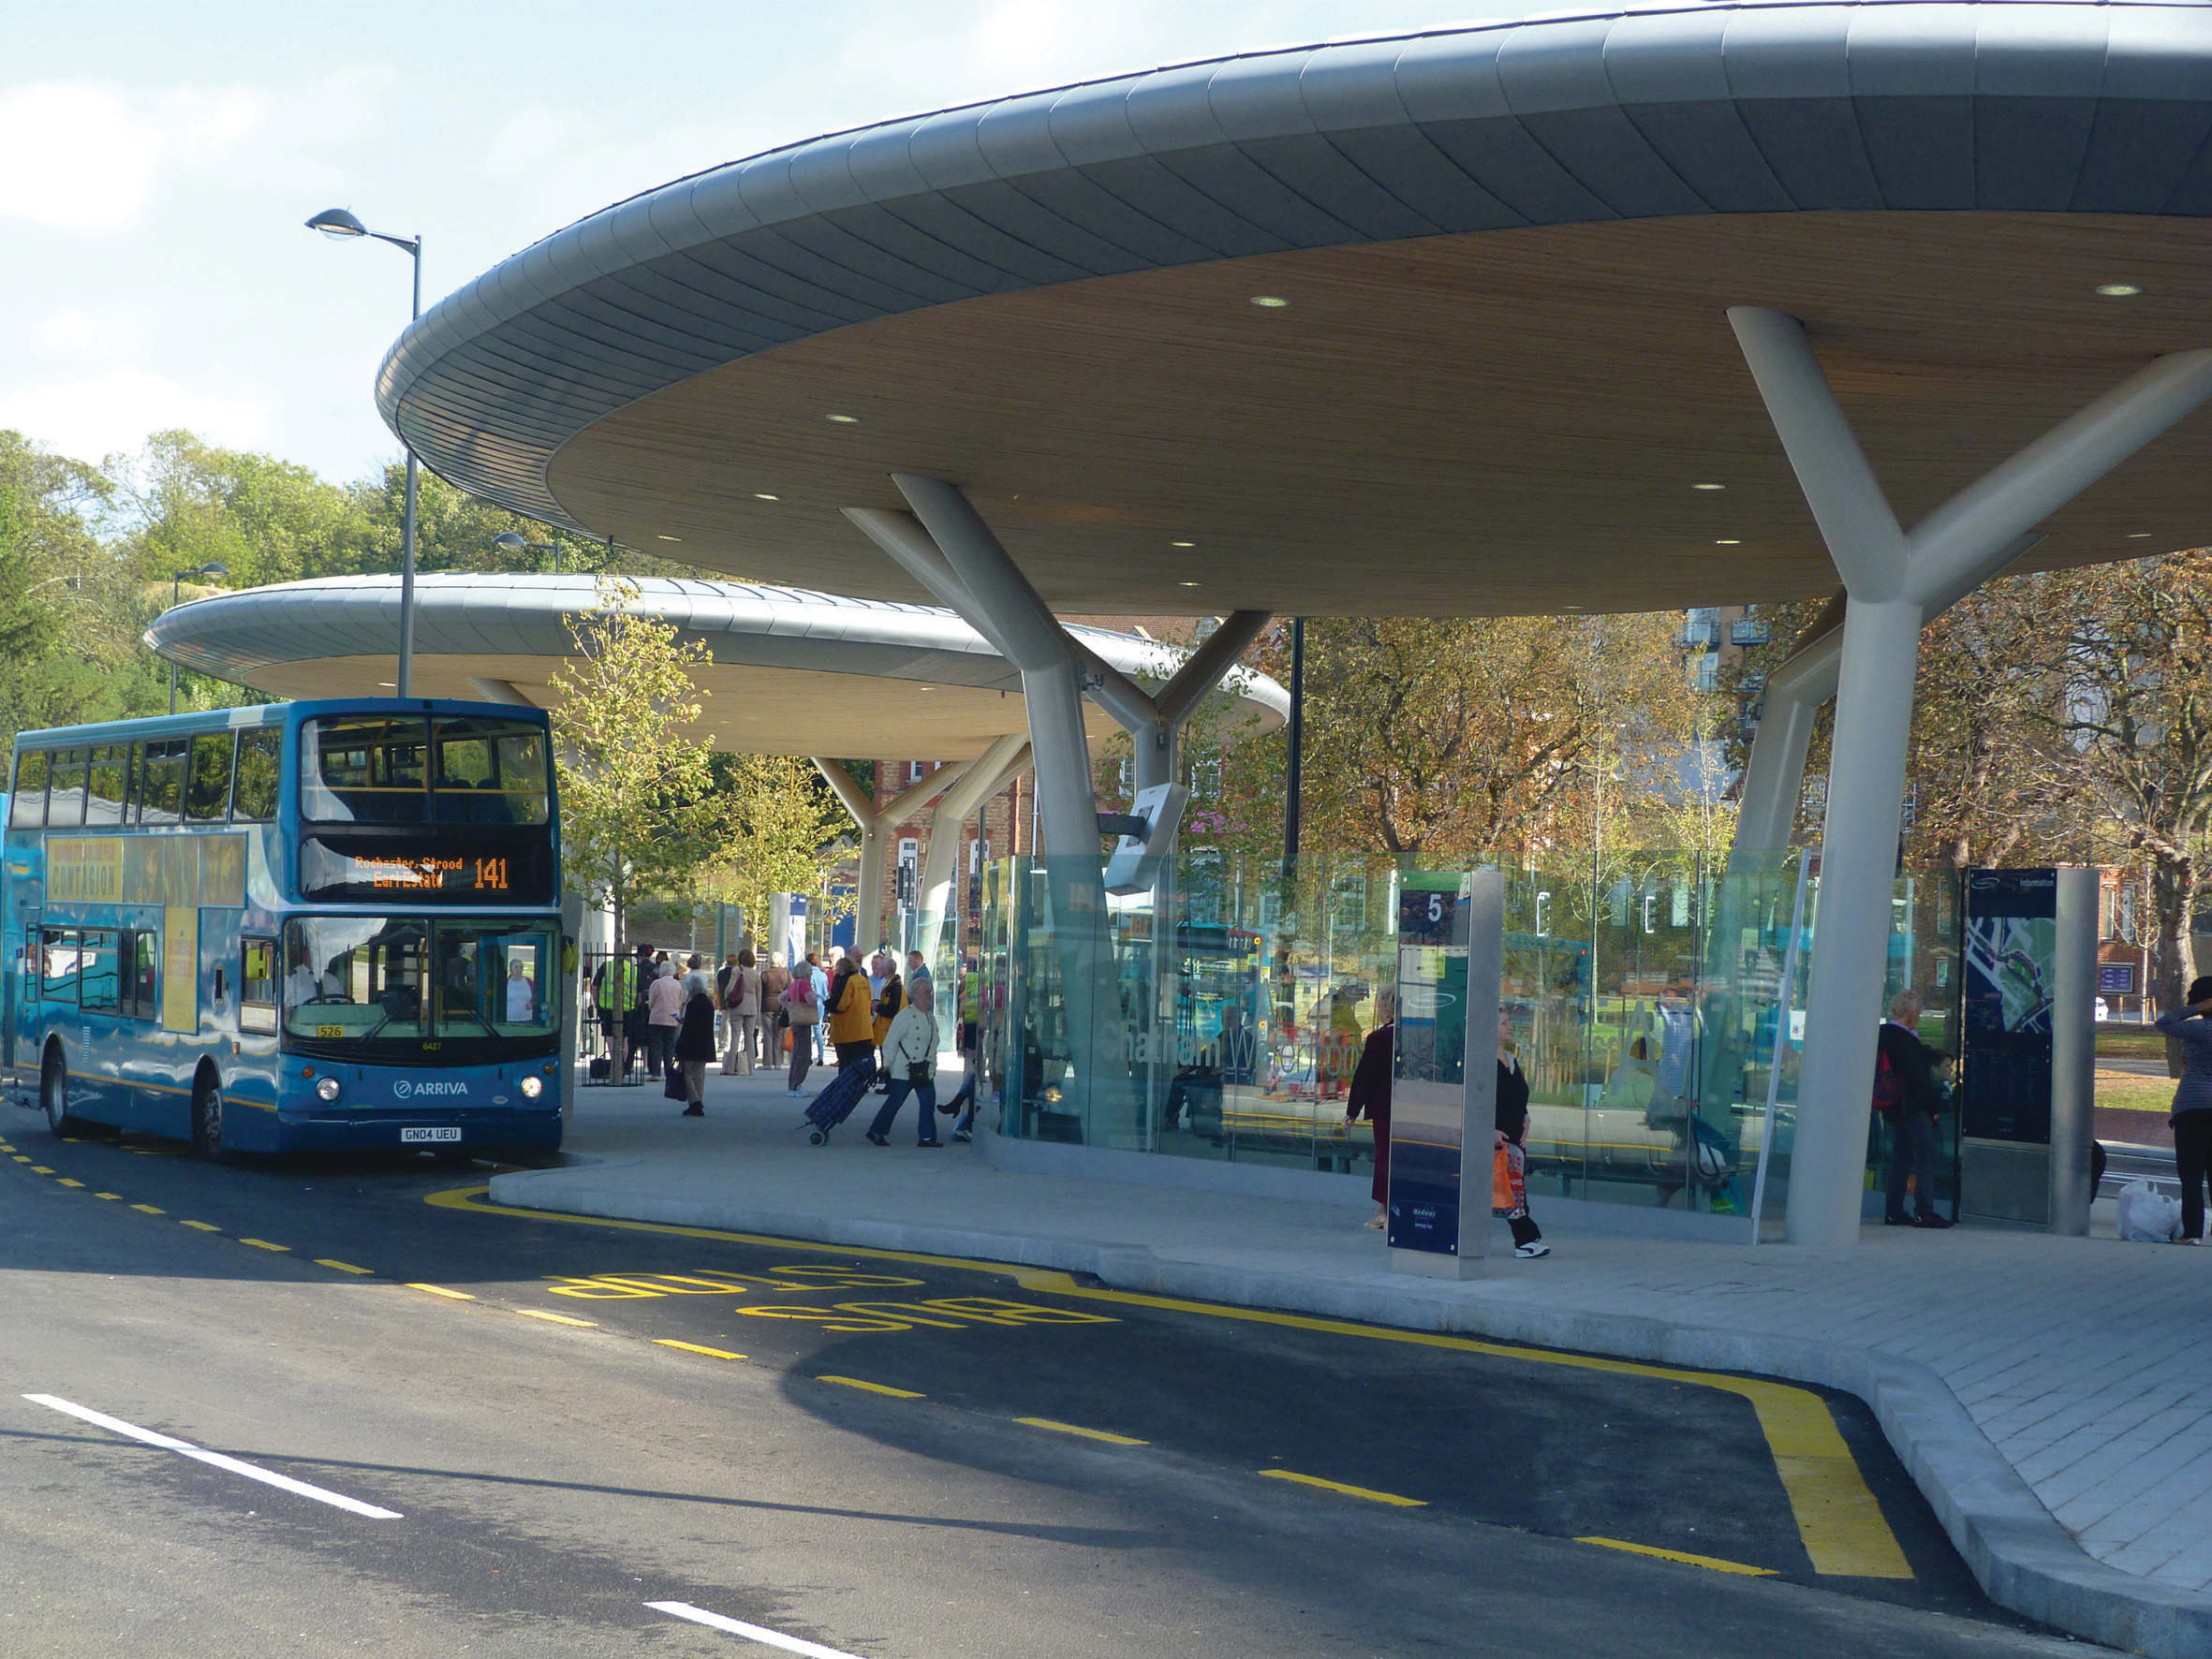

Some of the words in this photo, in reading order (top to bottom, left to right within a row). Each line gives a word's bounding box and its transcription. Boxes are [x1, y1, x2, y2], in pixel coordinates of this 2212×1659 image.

[354, 856, 420, 870] Rochester,
[421, 857, 464, 870] Strood
[52, 864, 116, 897] CONTAGION
[403, 871, 444, 888] Estate
[475, 858, 509, 889] 141
[2019, 878, 2055, 888] Information
[1427, 893, 1443, 923] 5
[320, 1026, 342, 1037] 526
[422, 1042, 441, 1051] 6427
[1100, 1020, 1221, 1067] Chatham
[414, 1082, 468, 1095] ARRIVA
[406, 1129, 433, 1140] GN04
[436, 1129, 457, 1139] UEU
[1412, 1208, 1437, 1218] Medway
[540, 1265, 926, 1299] STOP
[735, 1297, 1124, 1332] BUS
